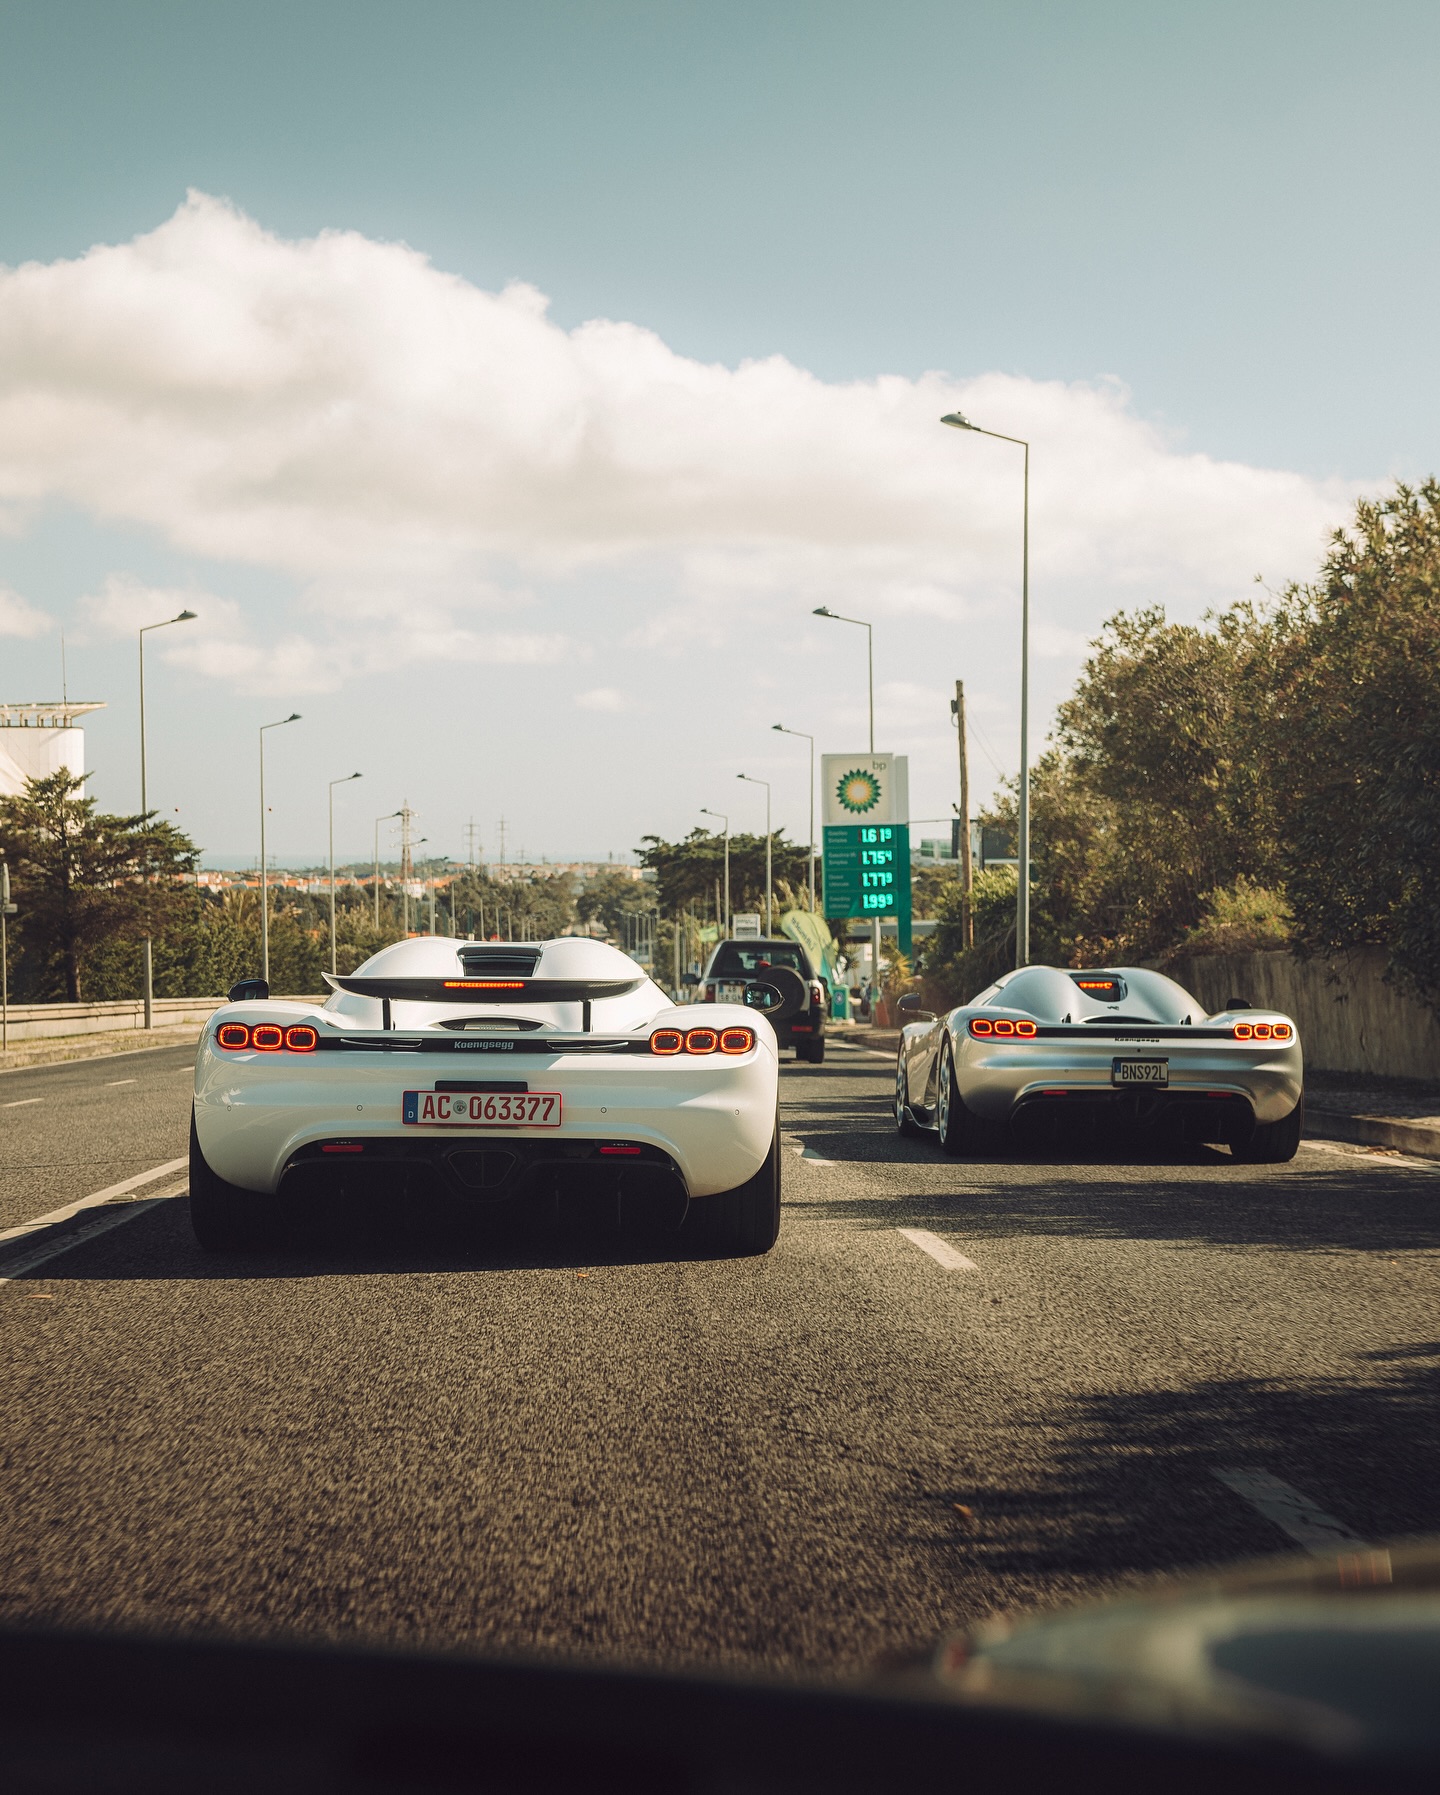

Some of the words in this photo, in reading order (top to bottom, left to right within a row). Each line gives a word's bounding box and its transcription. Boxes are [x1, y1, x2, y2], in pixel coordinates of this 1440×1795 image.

[872, 760, 887, 772] bp
[454, 1041, 514, 1050] Koenigsegg
[1122, 1064, 1166, 1080] BNS92L
[422, 1095, 451, 1120] AC
[469, 1096, 555, 1121] 063377
